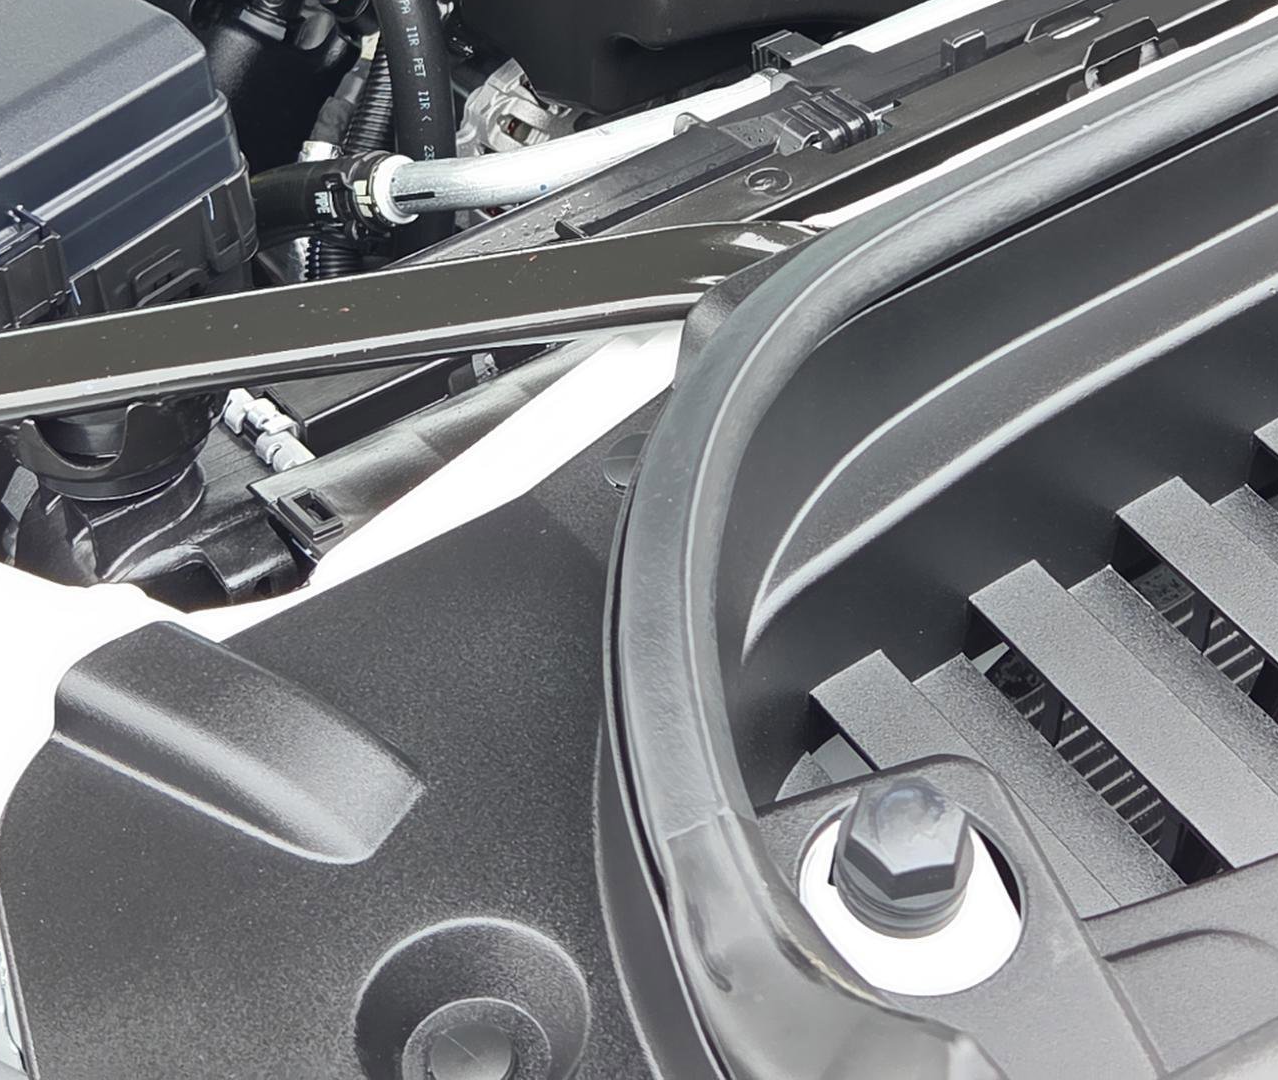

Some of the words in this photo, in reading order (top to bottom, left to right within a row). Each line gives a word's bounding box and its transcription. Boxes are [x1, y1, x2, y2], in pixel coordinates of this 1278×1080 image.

[398, 0, 411, 15] PA
[412, 57, 426, 77] PET
[314, 191, 331, 215] PIPE
